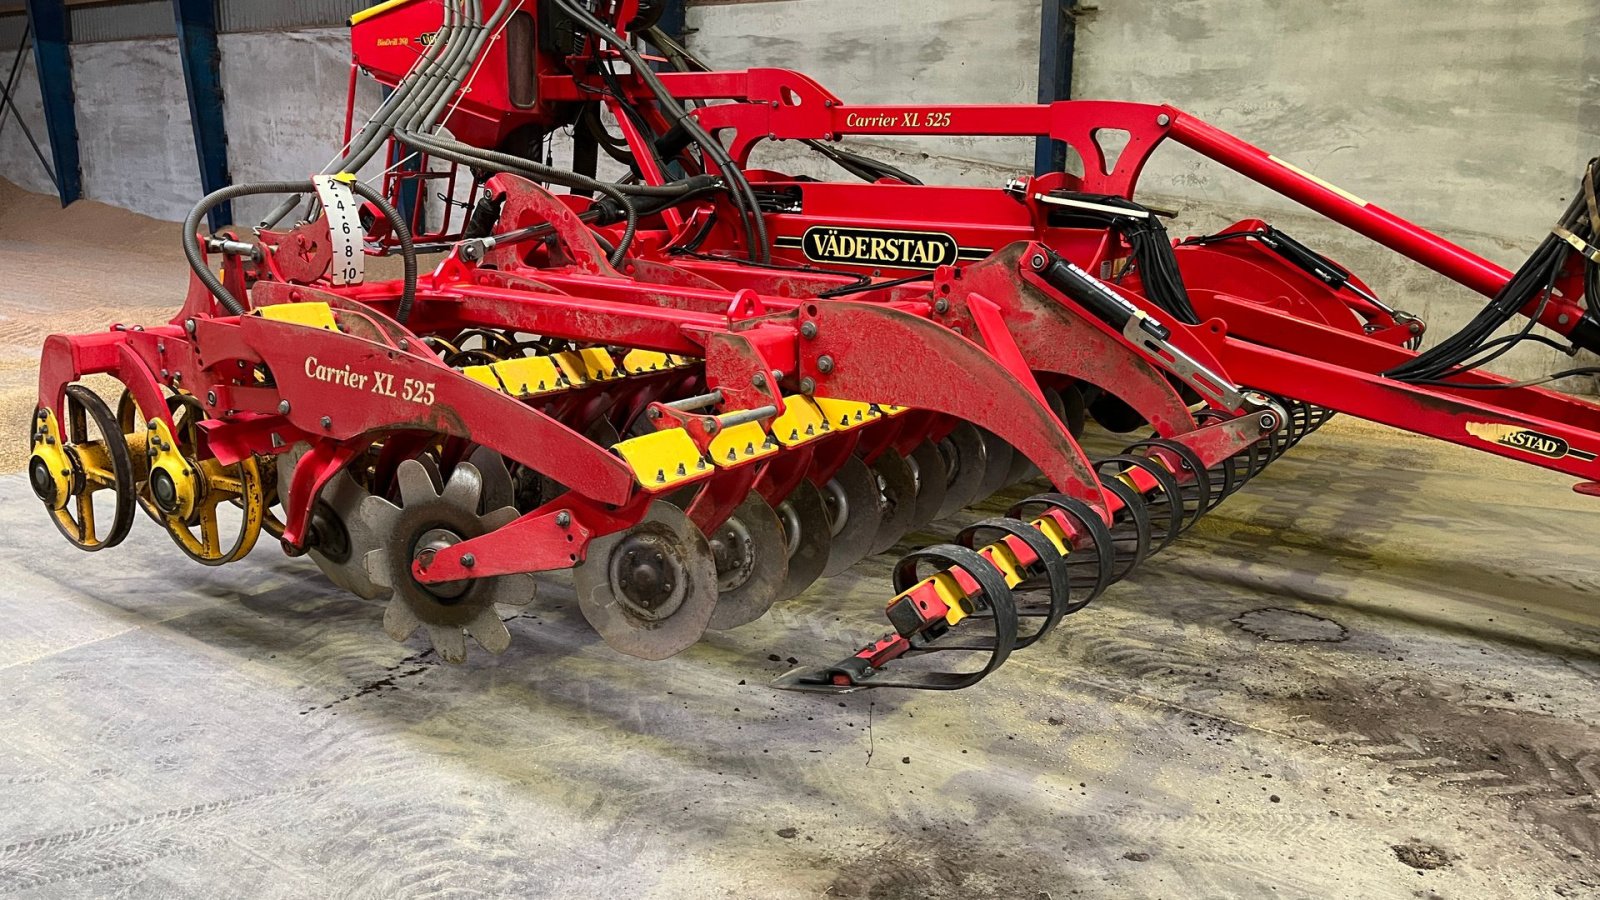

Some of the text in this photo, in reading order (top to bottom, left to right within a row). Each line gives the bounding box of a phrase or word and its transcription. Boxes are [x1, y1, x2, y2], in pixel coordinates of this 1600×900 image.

[846, 112, 952, 127] Carrier XL 525
[327, 180, 337, 190] 2
[336, 200, 345, 212] 4
[342, 222, 351, 235] 6
[345, 245, 353, 258] 8
[812, 229, 946, 264] VÄDERSTAD
[341, 267, 357, 280] 10
[304, 356, 436, 406] Carrier XL 525
[1498, 431, 1558, 453] RSTAD
